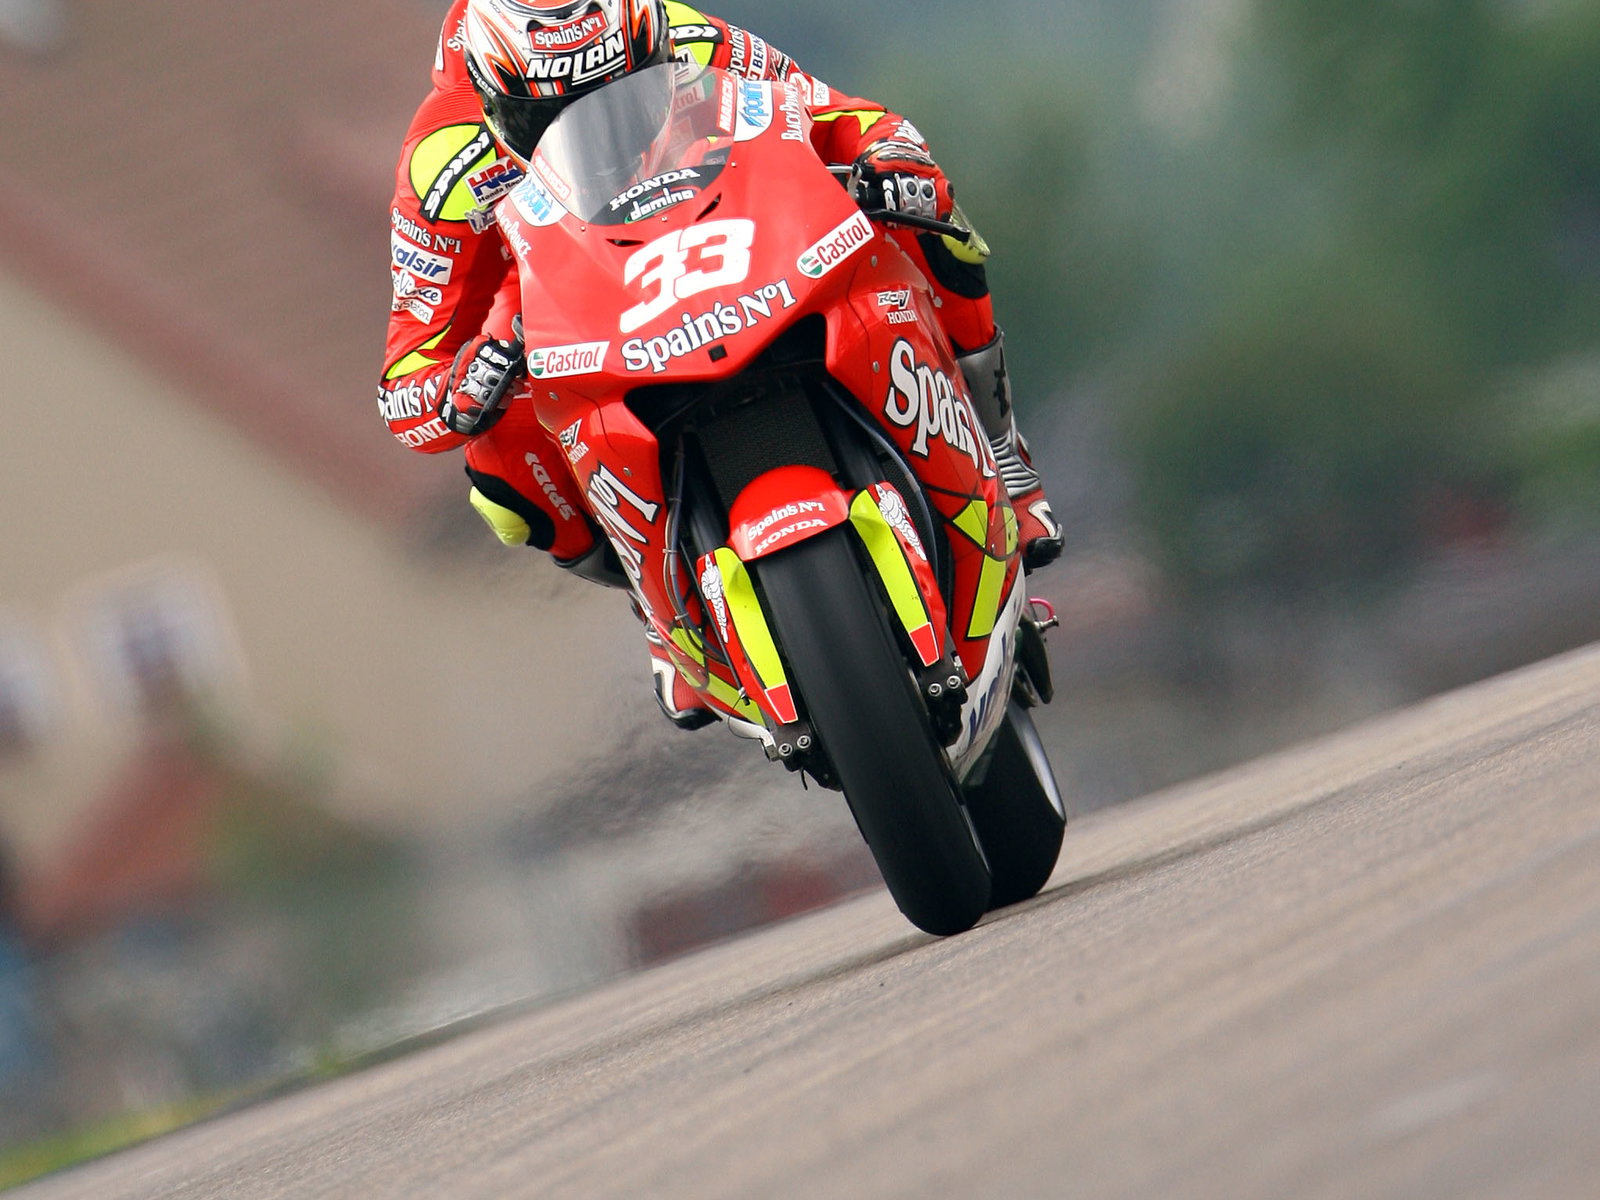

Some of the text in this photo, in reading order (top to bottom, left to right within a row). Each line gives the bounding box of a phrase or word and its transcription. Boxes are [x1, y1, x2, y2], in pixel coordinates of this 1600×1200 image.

[526, 30, 626, 81] NOLAN
[534, 24, 583, 48] Spain's
[424, 131, 490, 218] SPIDI
[609, 168, 701, 211] HONDA
[630, 187, 694, 221] domino
[391, 207, 432, 247] Spain's
[816, 217, 870, 266] Castrol
[619, 218, 756, 334] 33
[620, 301, 743, 374] Spain's
[887, 310, 918, 325] HONDA
[545, 348, 600, 374] Castrol
[748, 504, 799, 541] Spain's
[754, 518, 829, 555] HONDA
